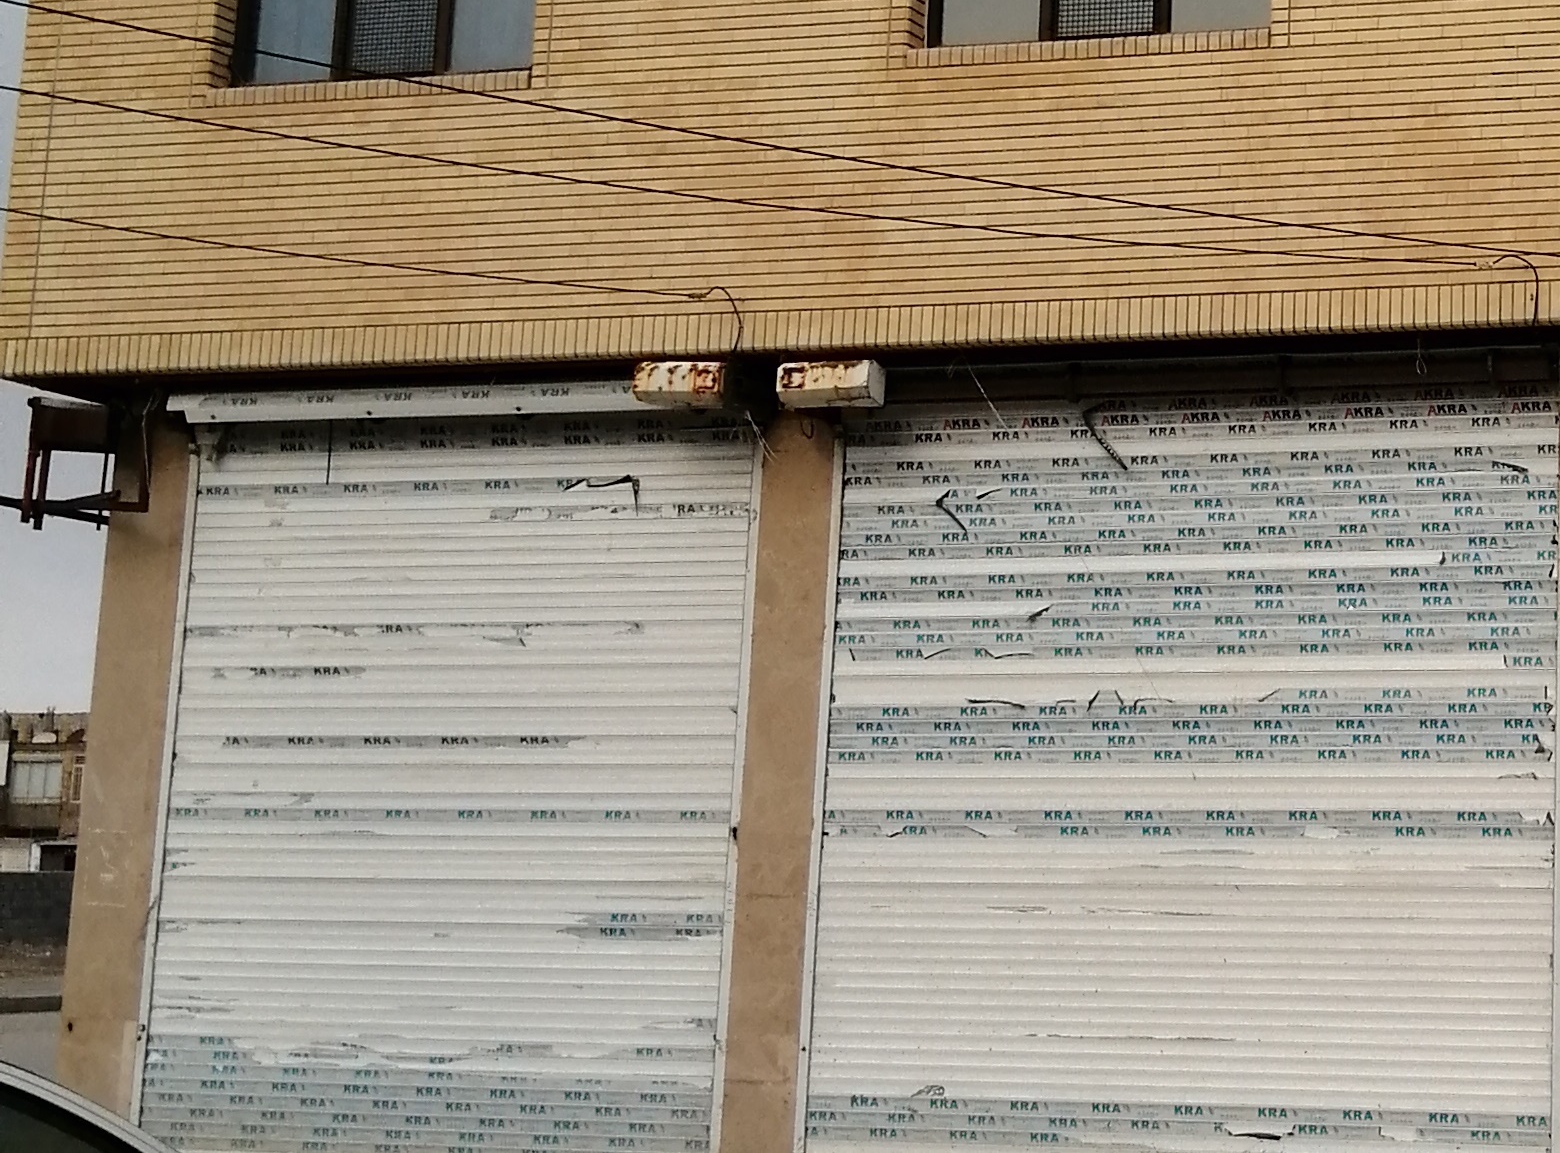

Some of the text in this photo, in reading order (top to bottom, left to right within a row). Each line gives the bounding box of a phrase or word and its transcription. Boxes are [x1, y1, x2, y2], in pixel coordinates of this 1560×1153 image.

[896, 445, 1483, 472] KRA KRA KRA KRA KRA KRA KRA KRA
[865, 533, 894, 543] KRA
[1019, 530, 1048, 540] KRA
[1098, 528, 1127, 540] KRA
[1178, 526, 1207, 538] KRA
[1258, 524, 1287, 536] KRA
[1339, 523, 1368, 535] KRA
[1422, 521, 1451, 533] KRA
[1504, 519, 1536, 531] KRA
[860, 579, 1535, 601] KRA KRA KRA KRA KRA KRA KRA KRA KRA
[856, 717, 1536, 733] KRA KRA KRA KRA KRA KRA KRA KRA KRA
[686, 912, 715, 924] KRA
[594, 1105, 623, 1117] KRA
[930, 1096, 959, 1111] KRA
[1010, 1099, 1039, 1112] KRA
[1092, 1100, 1121, 1115] KRA
[1173, 1103, 1206, 1117] KRA
[1257, 1105, 1289, 1120] KRA
[1342, 1108, 1375, 1122] KRA
[1428, 1110, 1461, 1125] KRA
[1516, 1113, 1548, 1128] KRA
